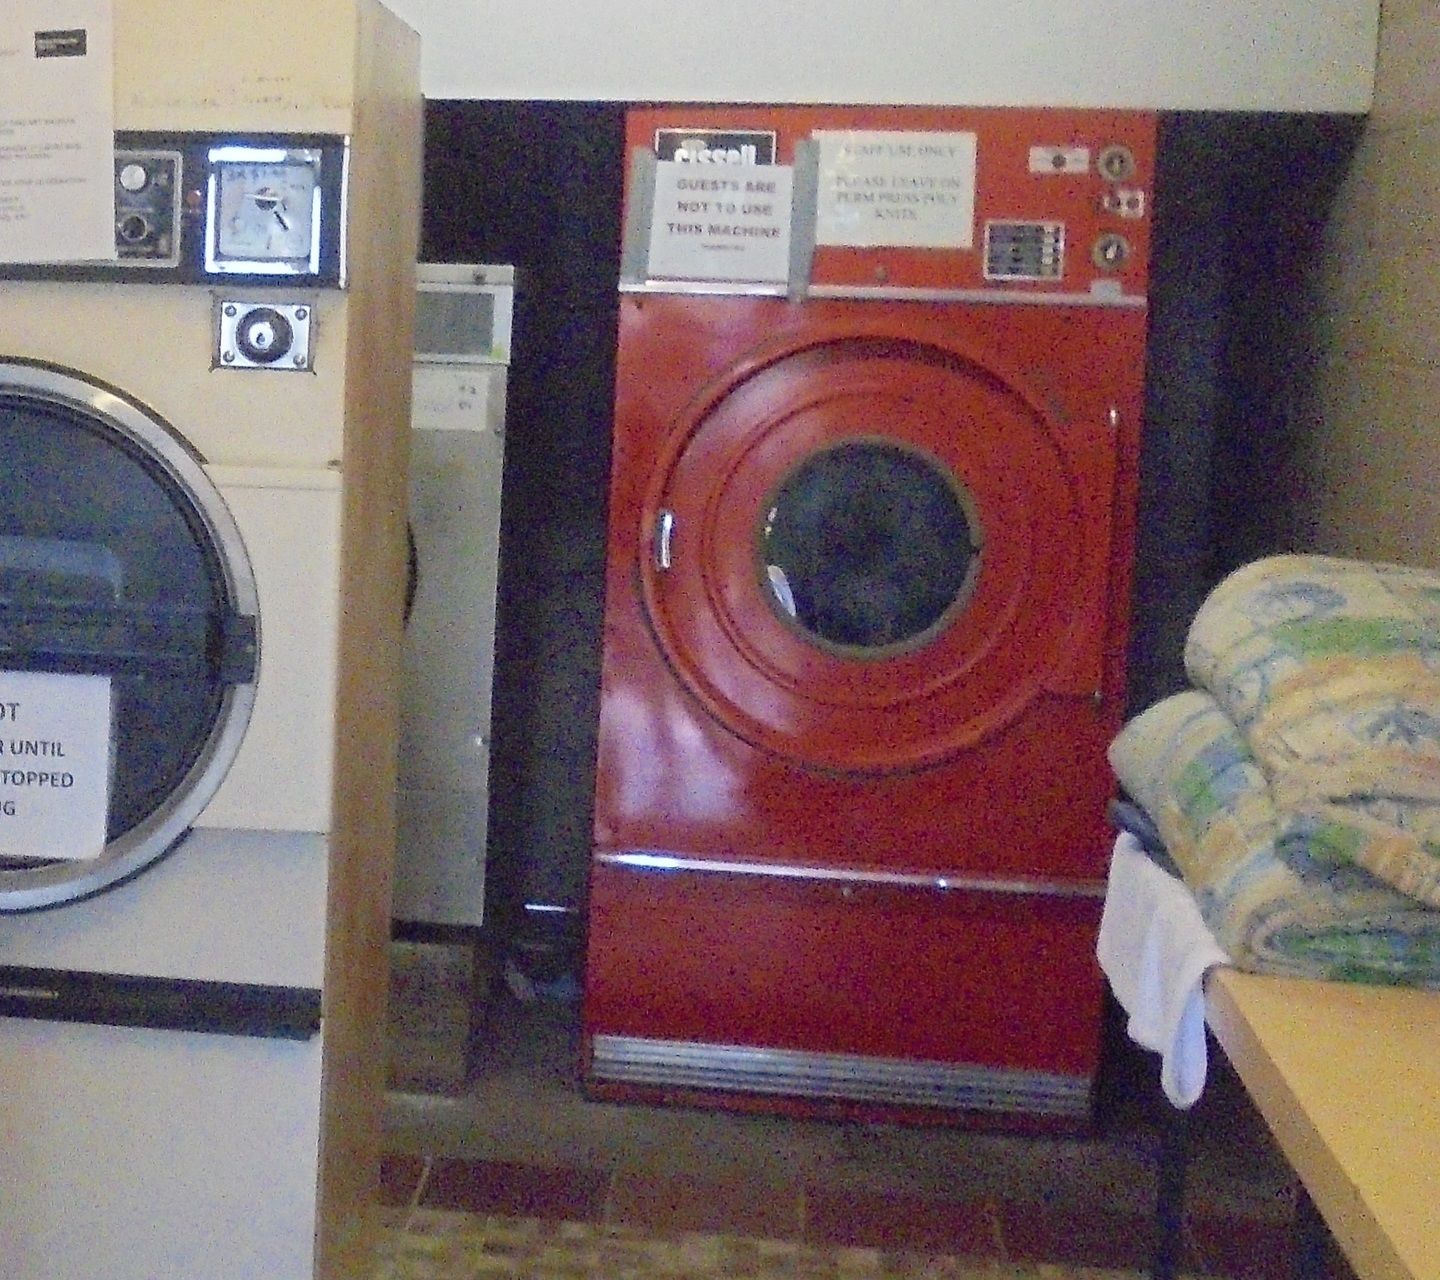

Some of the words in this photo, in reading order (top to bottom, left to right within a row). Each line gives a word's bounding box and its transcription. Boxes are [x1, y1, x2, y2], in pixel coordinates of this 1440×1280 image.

[918, 145, 957, 157] ONLY
[676, 178, 739, 191] GUESTS
[746, 180, 776, 194] ARE
[677, 201, 708, 213] NOT
[715, 202, 736, 214] TO
[742, 204, 772, 216] USE
[667, 222, 702, 235] THIS
[708, 223, 780, 238] MACHINE
[10, 739, 65, 757] UNTIL
